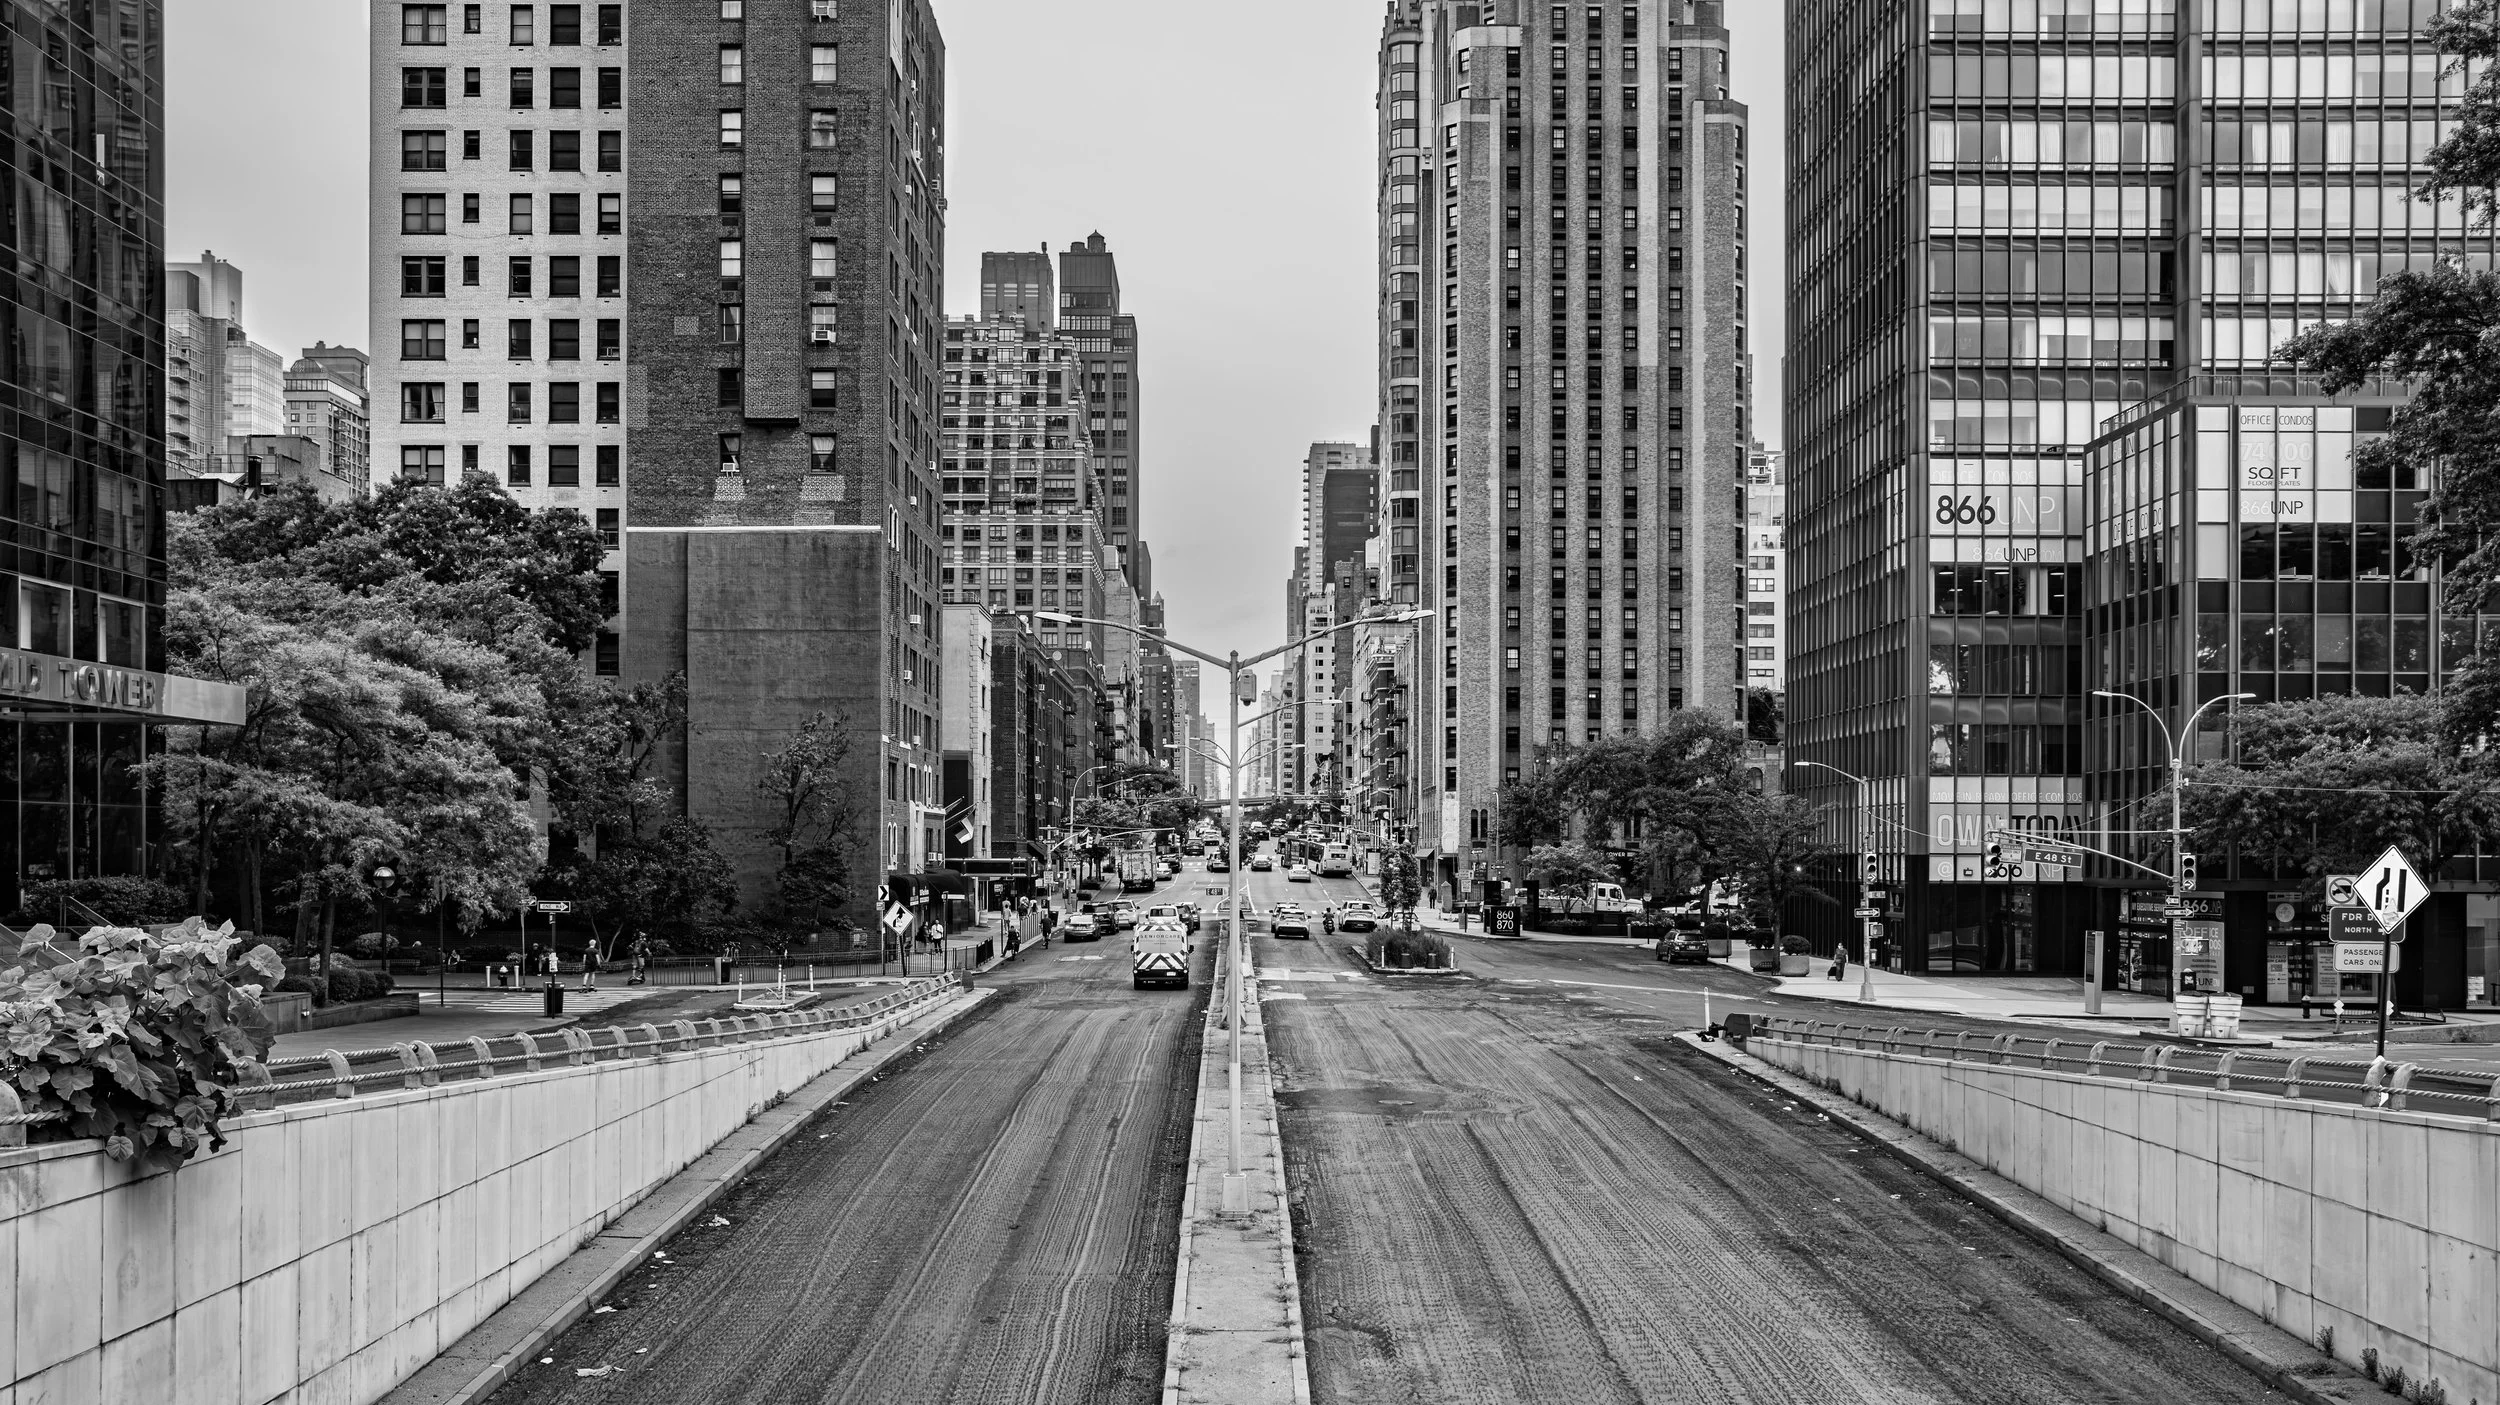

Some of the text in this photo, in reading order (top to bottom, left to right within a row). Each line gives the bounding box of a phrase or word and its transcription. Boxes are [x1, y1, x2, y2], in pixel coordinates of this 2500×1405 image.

[2240, 414, 2314, 426] OFFICE CONDOS
[2248, 466, 2302, 480] SQ FT
[58, 660, 156, 709] TOWER
[2012, 792, 2043, 801] OFFICE
[2035, 852, 2072, 864] E 48 St
[1496, 910, 1514, 920] 860
[2341, 912, 2363, 921] FDR
[1496, 920, 1514, 930] 870
[2343, 948, 2383, 956] PASSENGE
